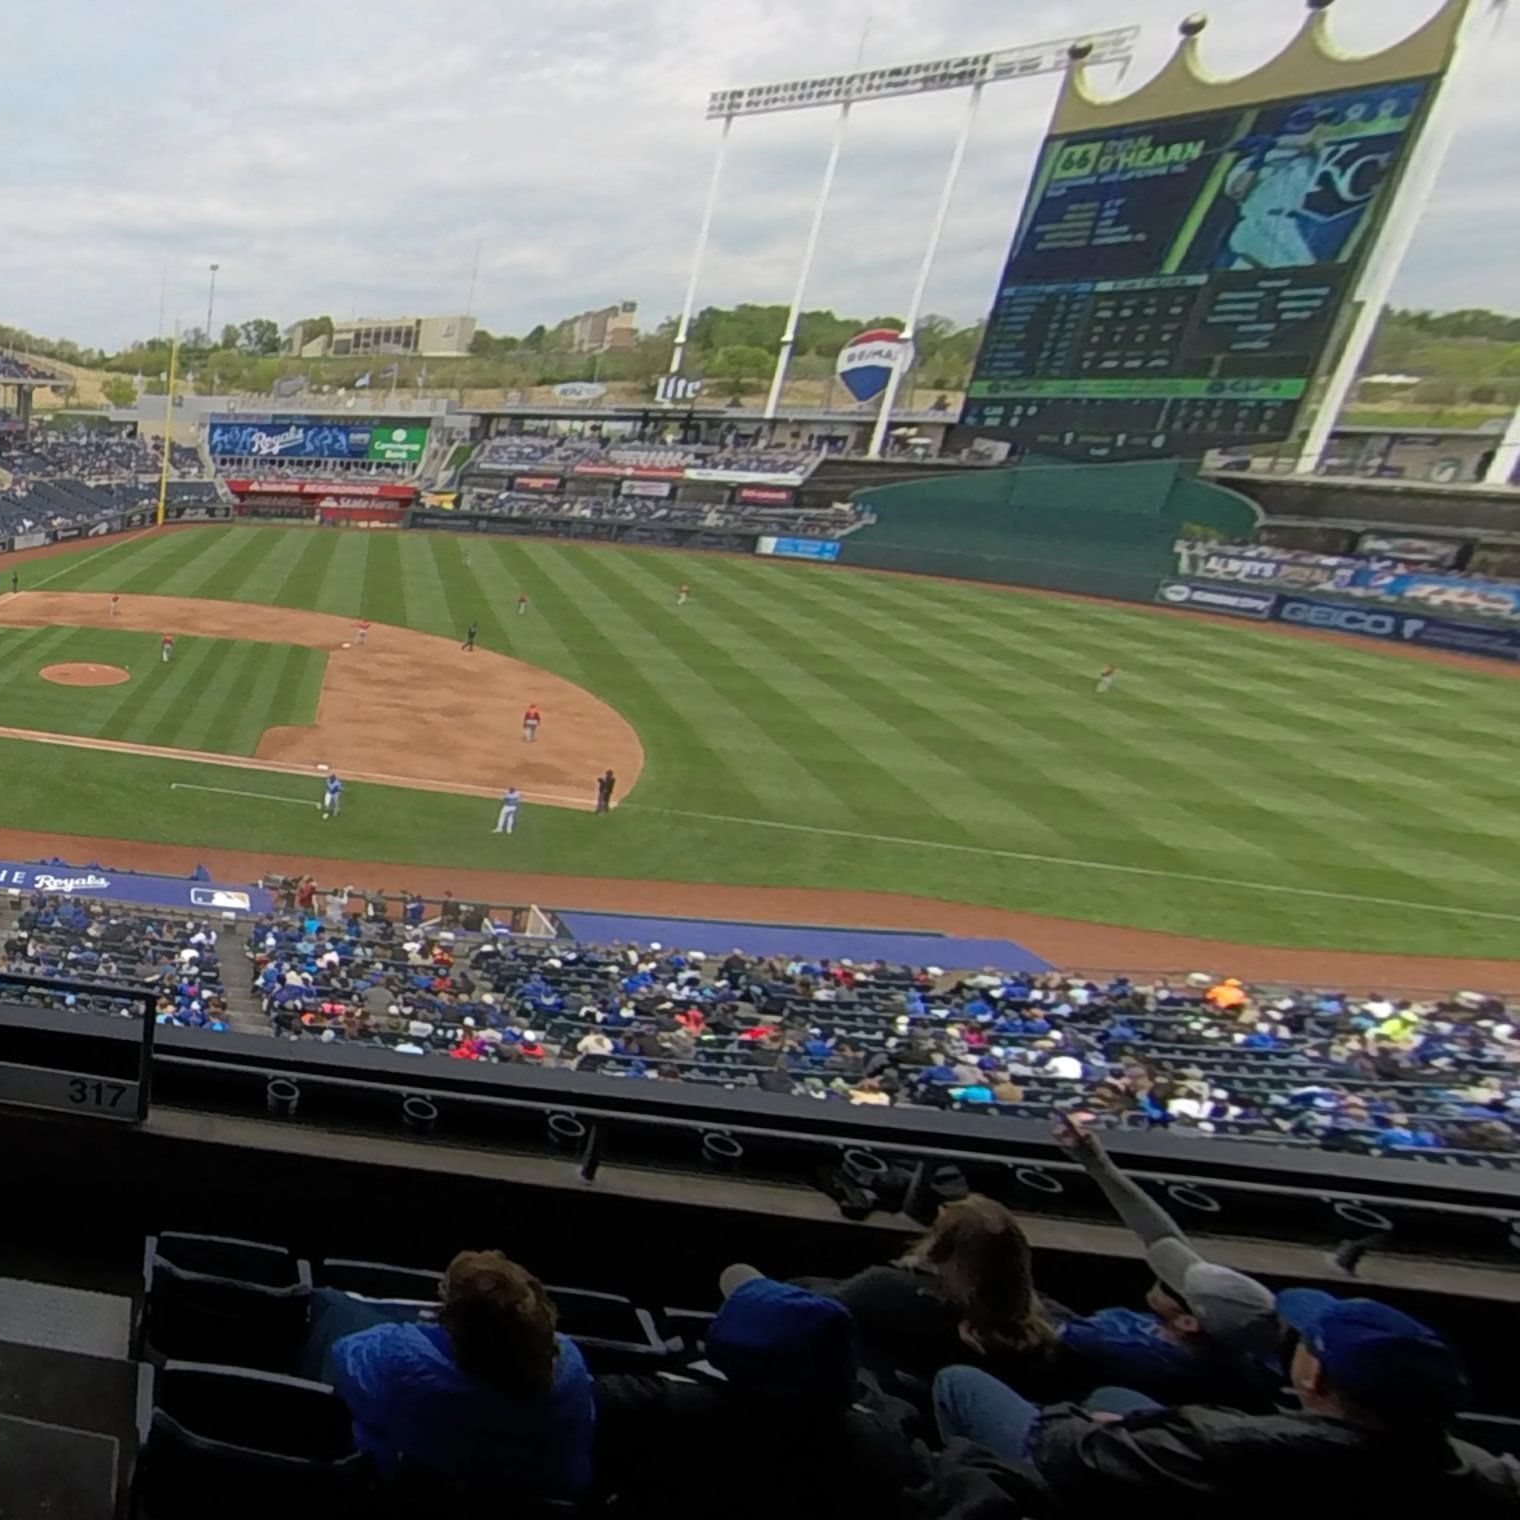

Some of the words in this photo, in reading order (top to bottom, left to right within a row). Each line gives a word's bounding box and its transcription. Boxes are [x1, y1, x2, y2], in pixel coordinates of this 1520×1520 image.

[1097, 139, 1206, 173] O'HEARN
[1306, 142, 1391, 201] KC
[846, 348, 898, 362] RE/MA
[251, 425, 304, 455] Royals
[338, 496, 369, 509] State
[1281, 602, 1395, 635] GEICO
[34, 874, 111, 891] Royals
[68, 1079, 128, 1108] 317
